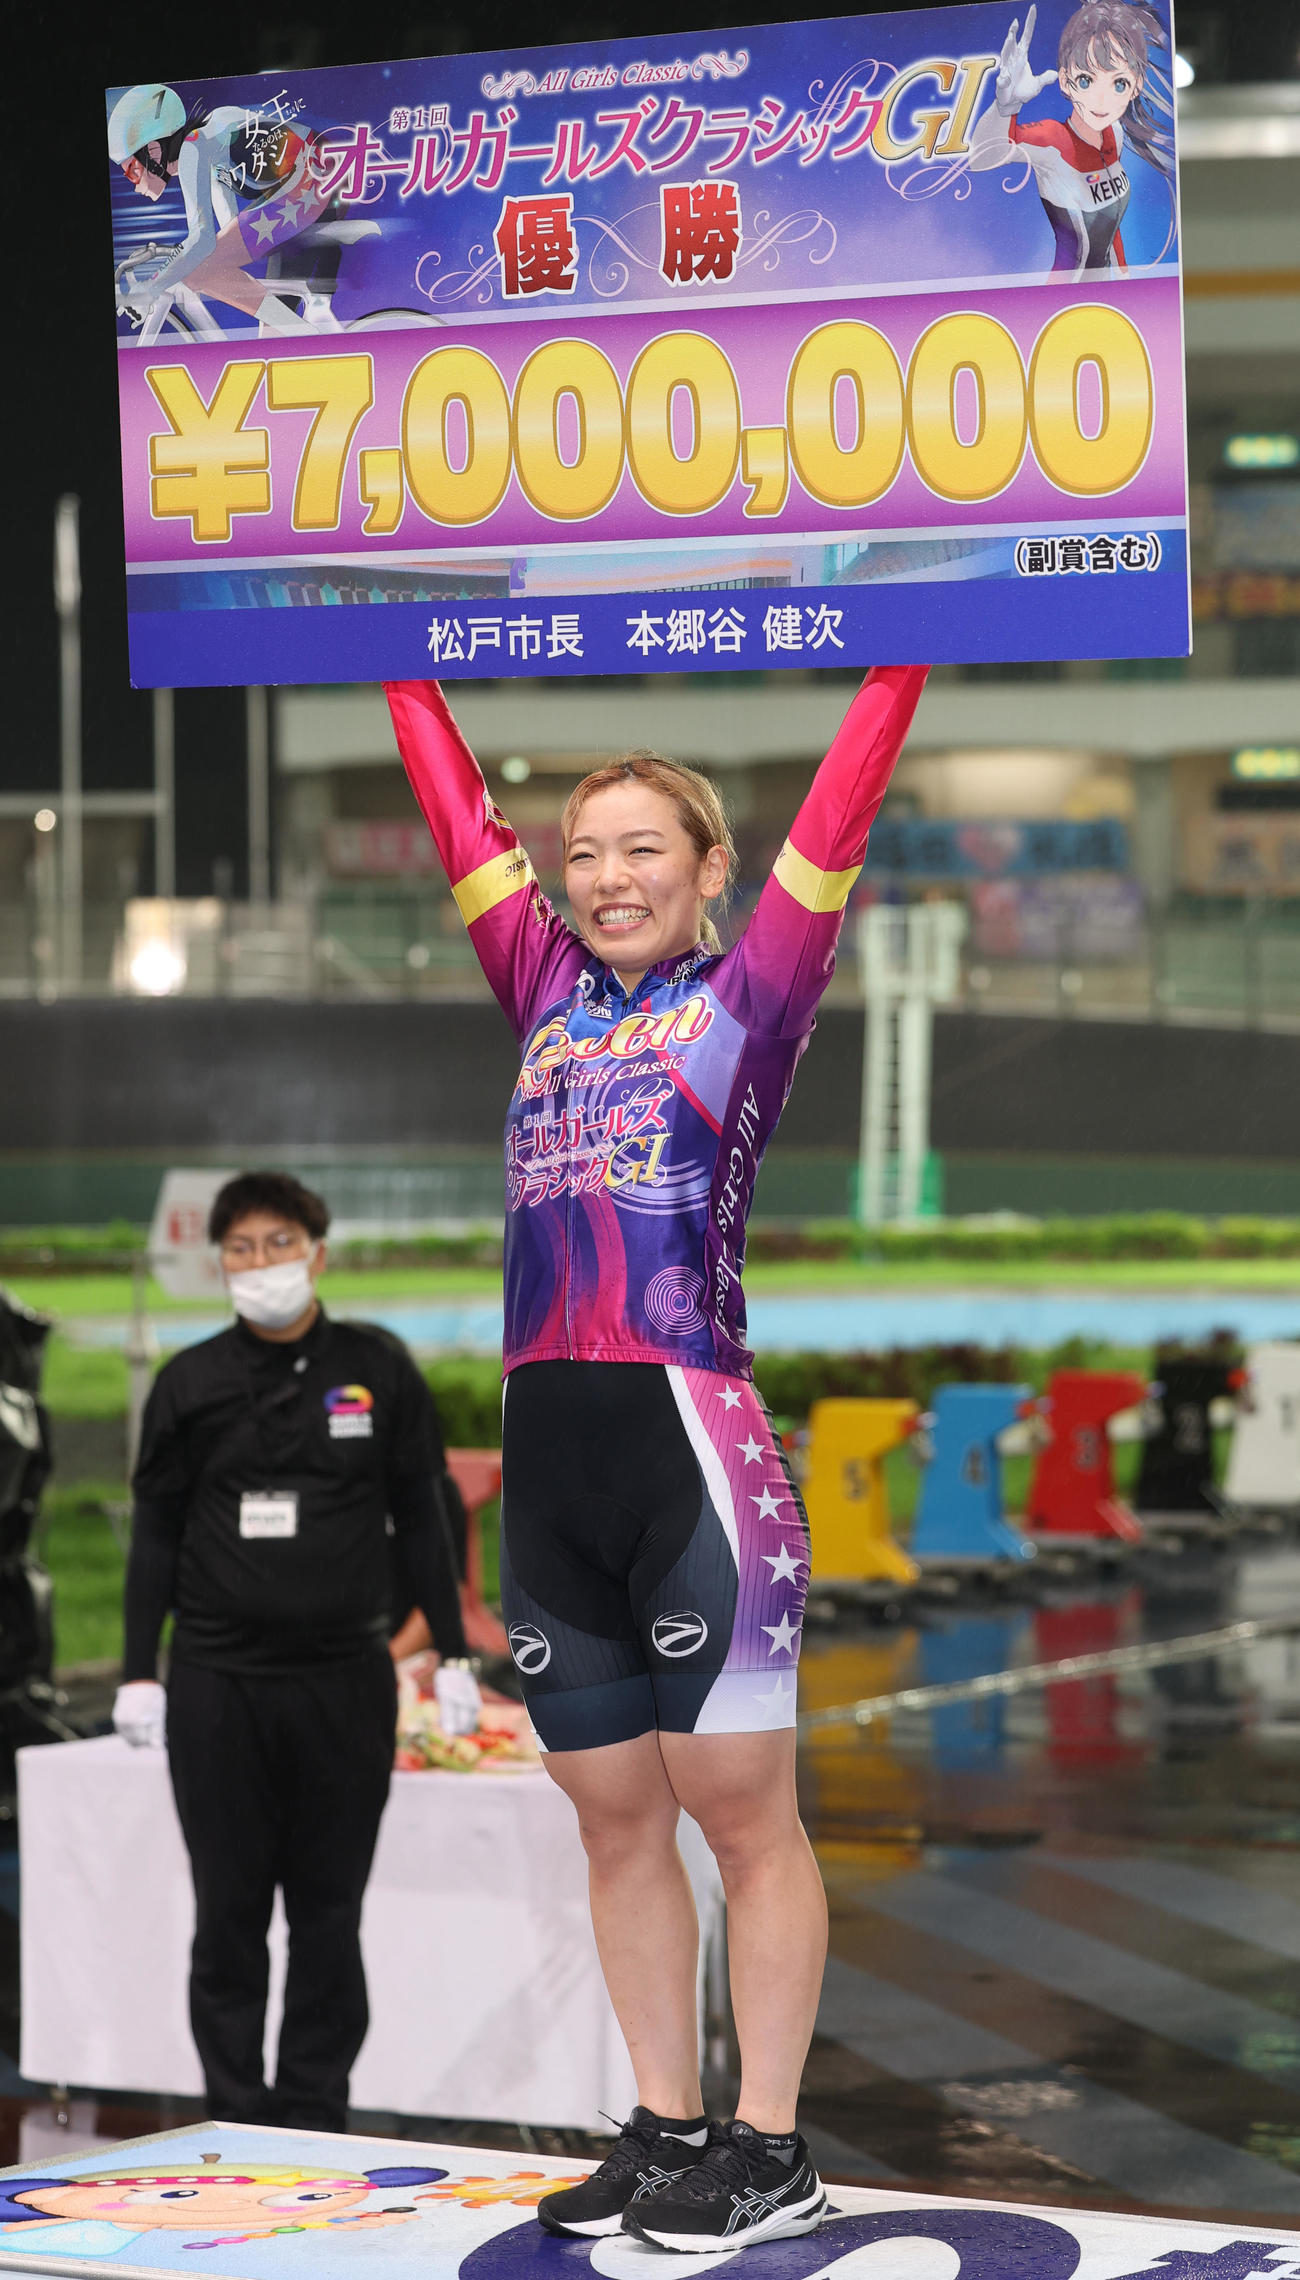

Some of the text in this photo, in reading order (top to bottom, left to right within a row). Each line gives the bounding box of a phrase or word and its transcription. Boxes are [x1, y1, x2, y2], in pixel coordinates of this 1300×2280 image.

[536, 60, 689, 93] All Girls Classic
[391, 105, 448, 131] 第1回
[229, 139, 288, 190] ワタシ
[145, 302, 1156, 544] ¥7,000,000
[1013, 533, 1163, 578] (副賞含む)
[427, 603, 846, 662] 松戸市長 本郷谷 健次
[537, 1073, 561, 1099] All
[564, 1066, 610, 1090] Girls
[615, 1052, 686, 1081] Classic
[506, 1090, 672, 1165] オールガールズ
[736, 1082, 761, 1152] All
[716, 1146, 746, 1233] Girls
